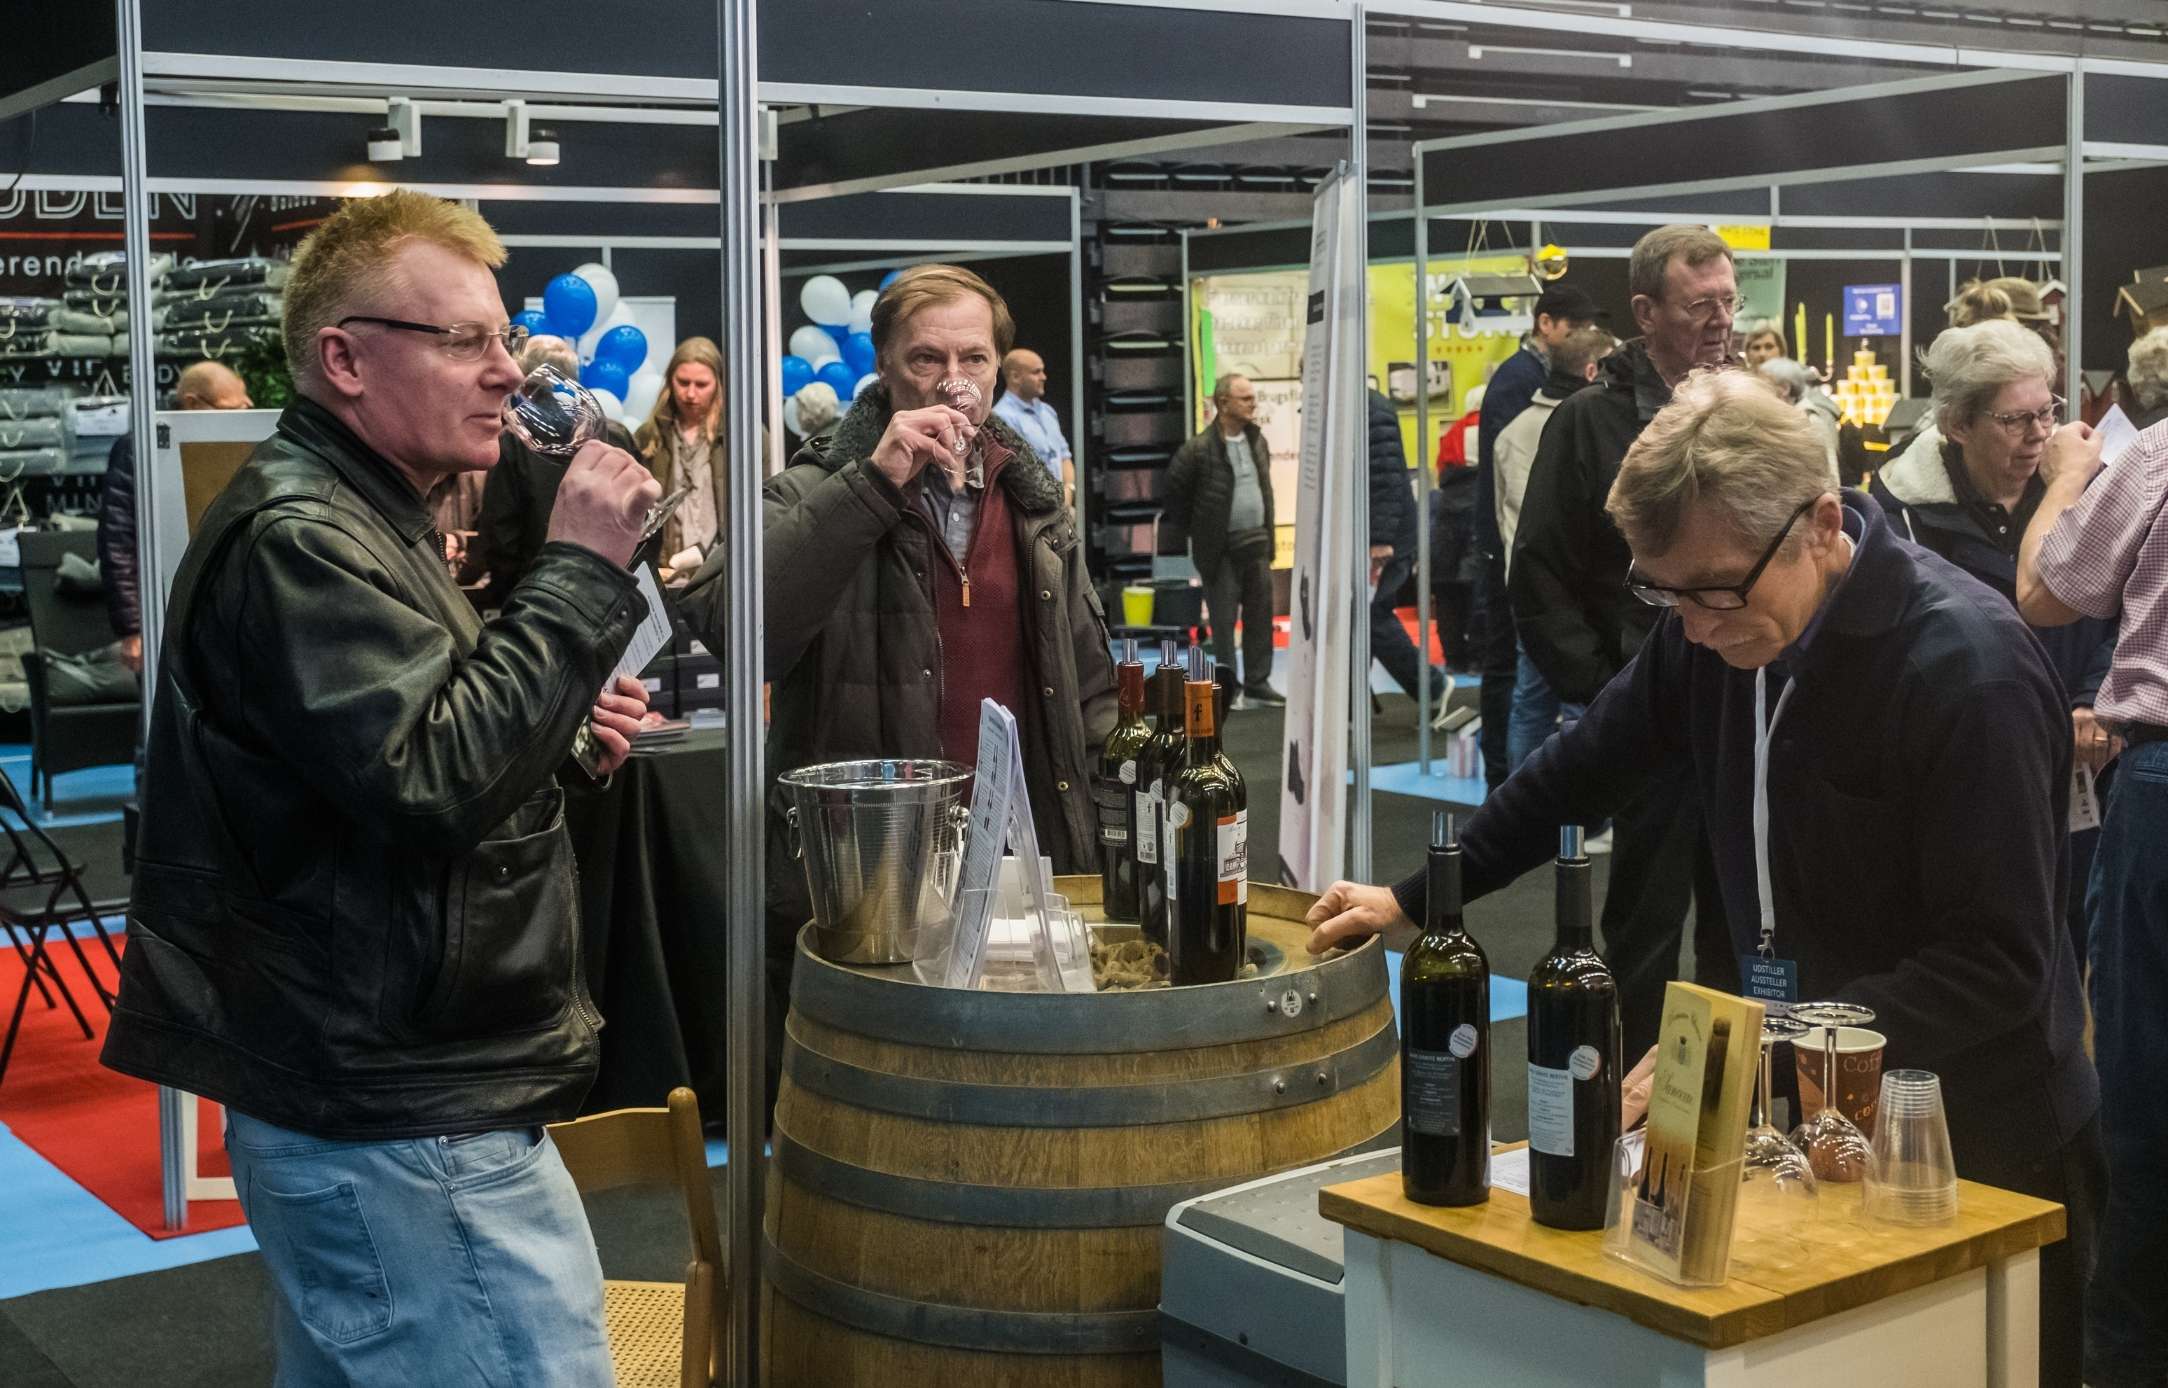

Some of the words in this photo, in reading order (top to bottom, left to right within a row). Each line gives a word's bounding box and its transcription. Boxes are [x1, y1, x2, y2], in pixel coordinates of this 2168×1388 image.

[1752, 964, 1785, 976] UDSTILLER
[1751, 975, 1788, 988] AUSSTELLER
[1753, 986, 1785, 998] EXHIBITOR
